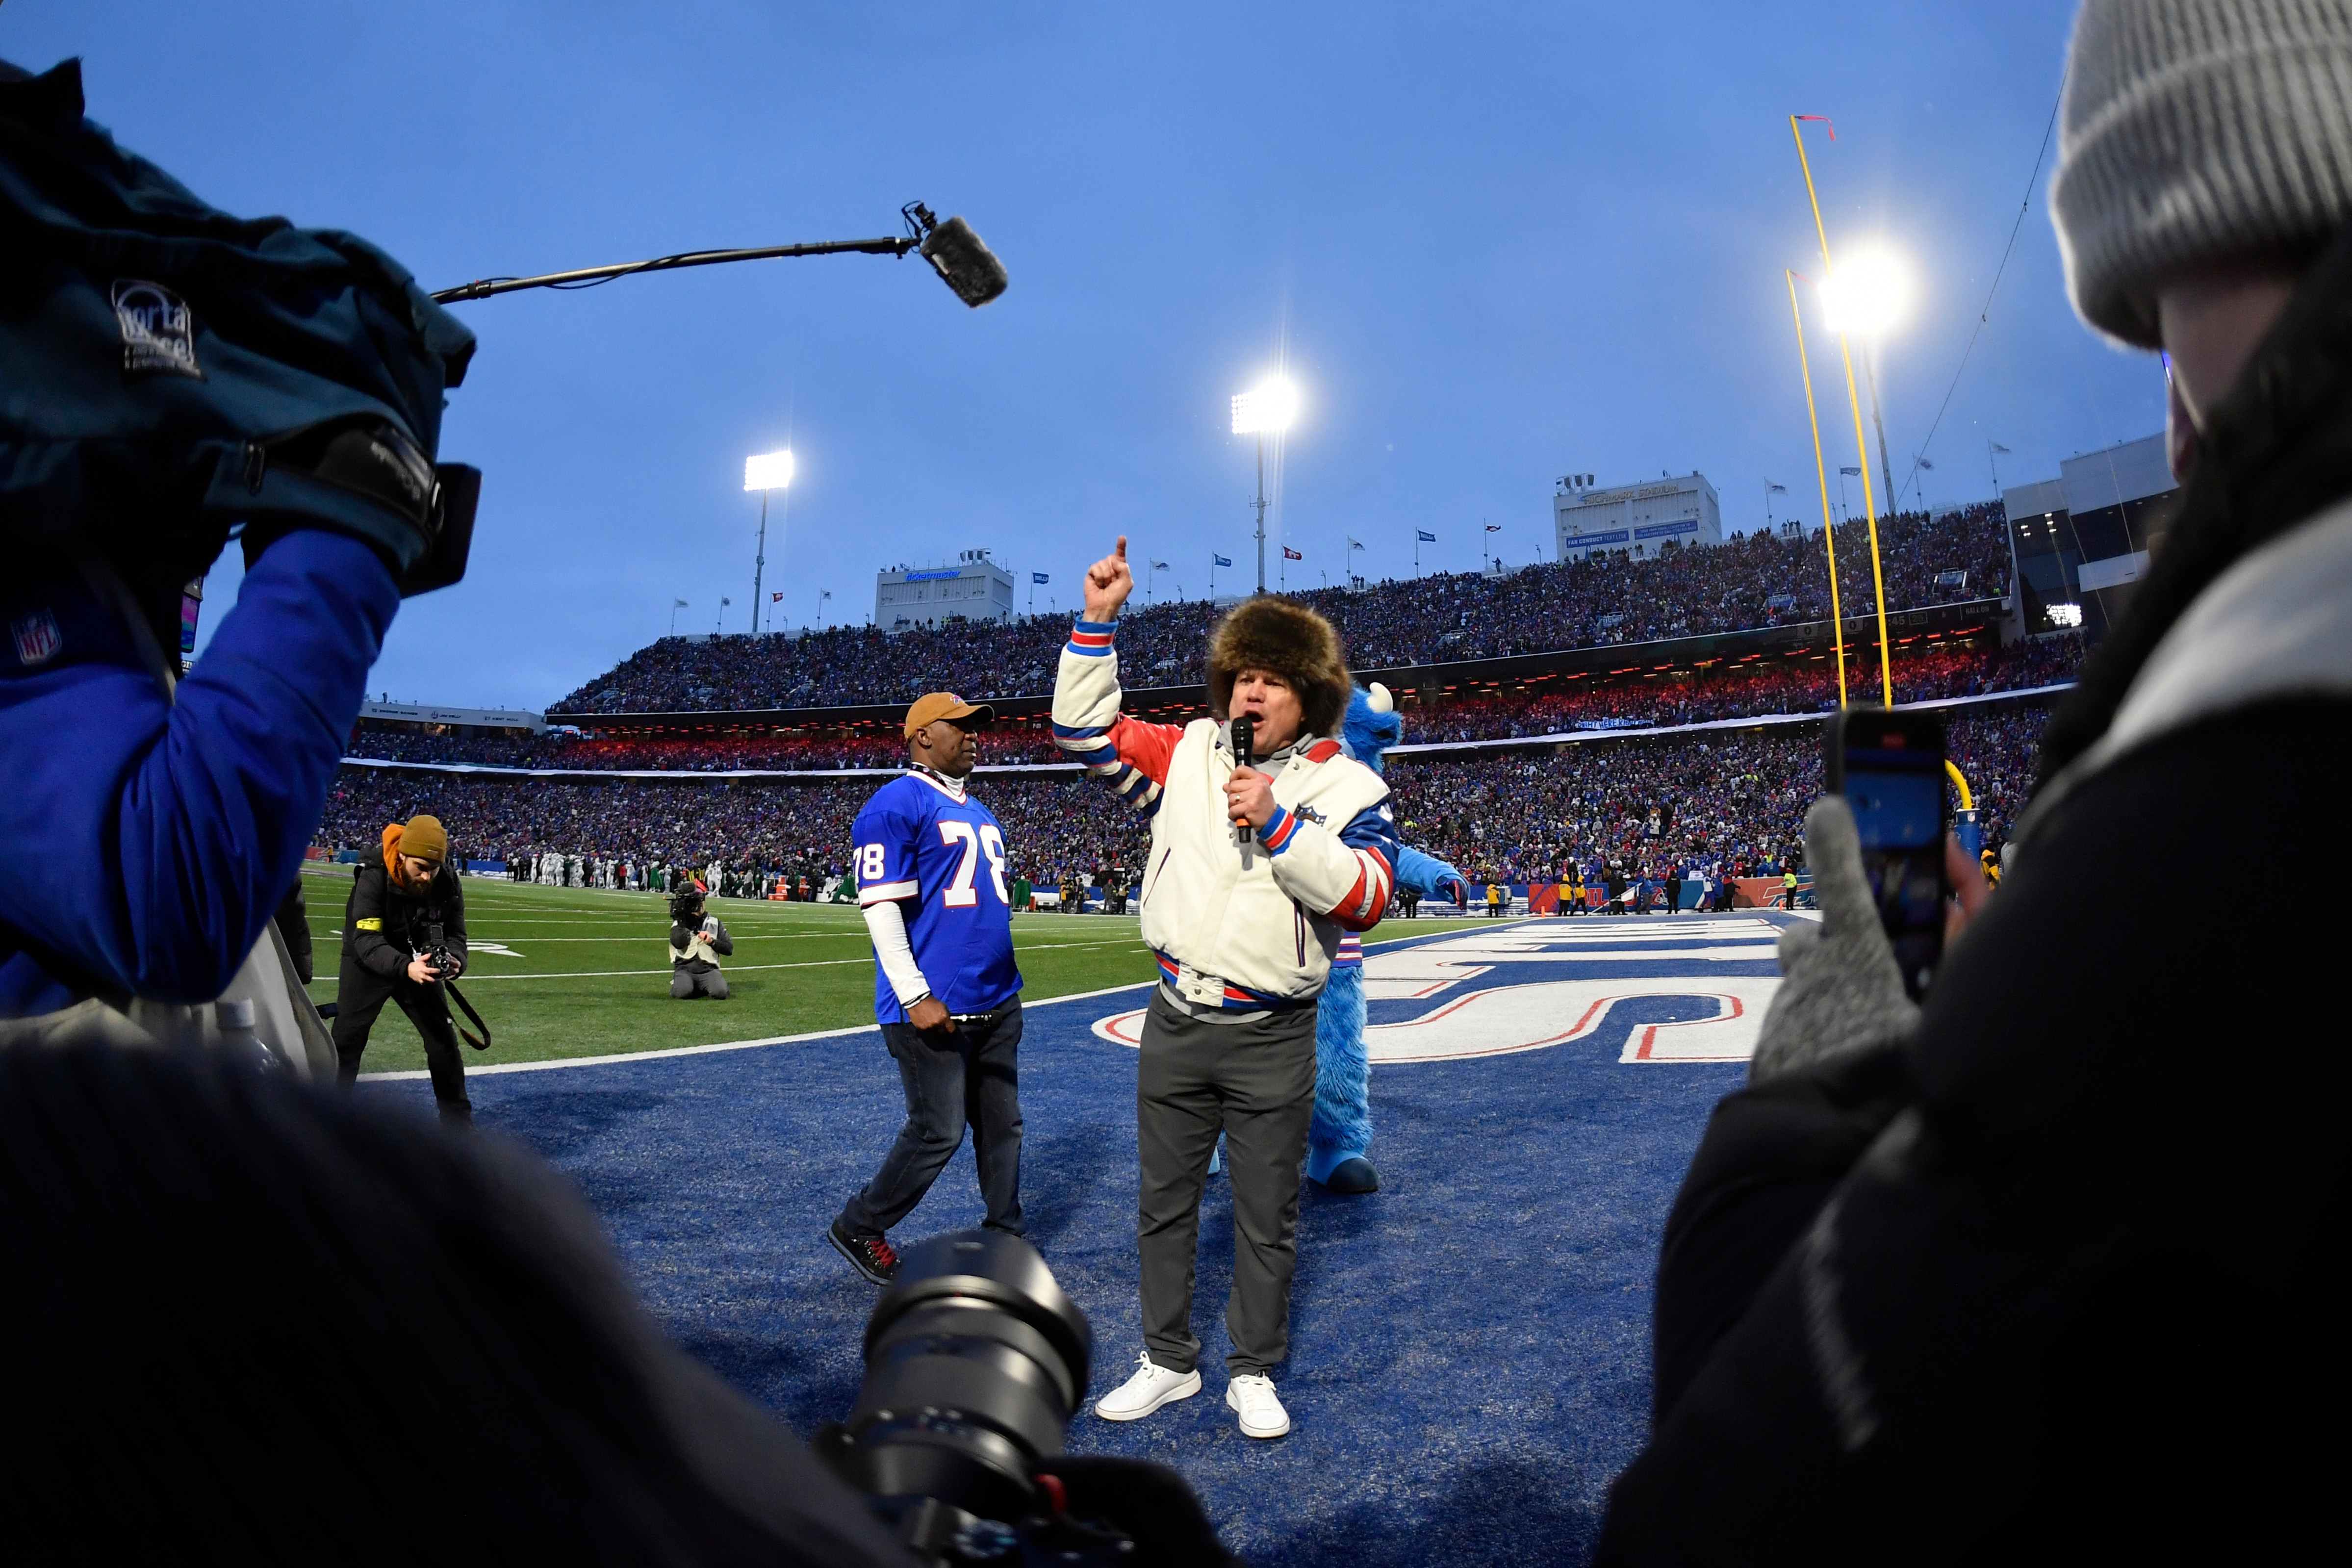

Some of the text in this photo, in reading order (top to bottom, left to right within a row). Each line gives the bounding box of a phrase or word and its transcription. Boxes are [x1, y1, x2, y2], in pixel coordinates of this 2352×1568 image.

[1639, 485, 1679, 497] STADIUM
[905, 569, 961, 582] ticketmaster
[22, 625, 56, 656] NFL
[853, 843, 884, 884] 78
[937, 820, 1009, 908] 78
